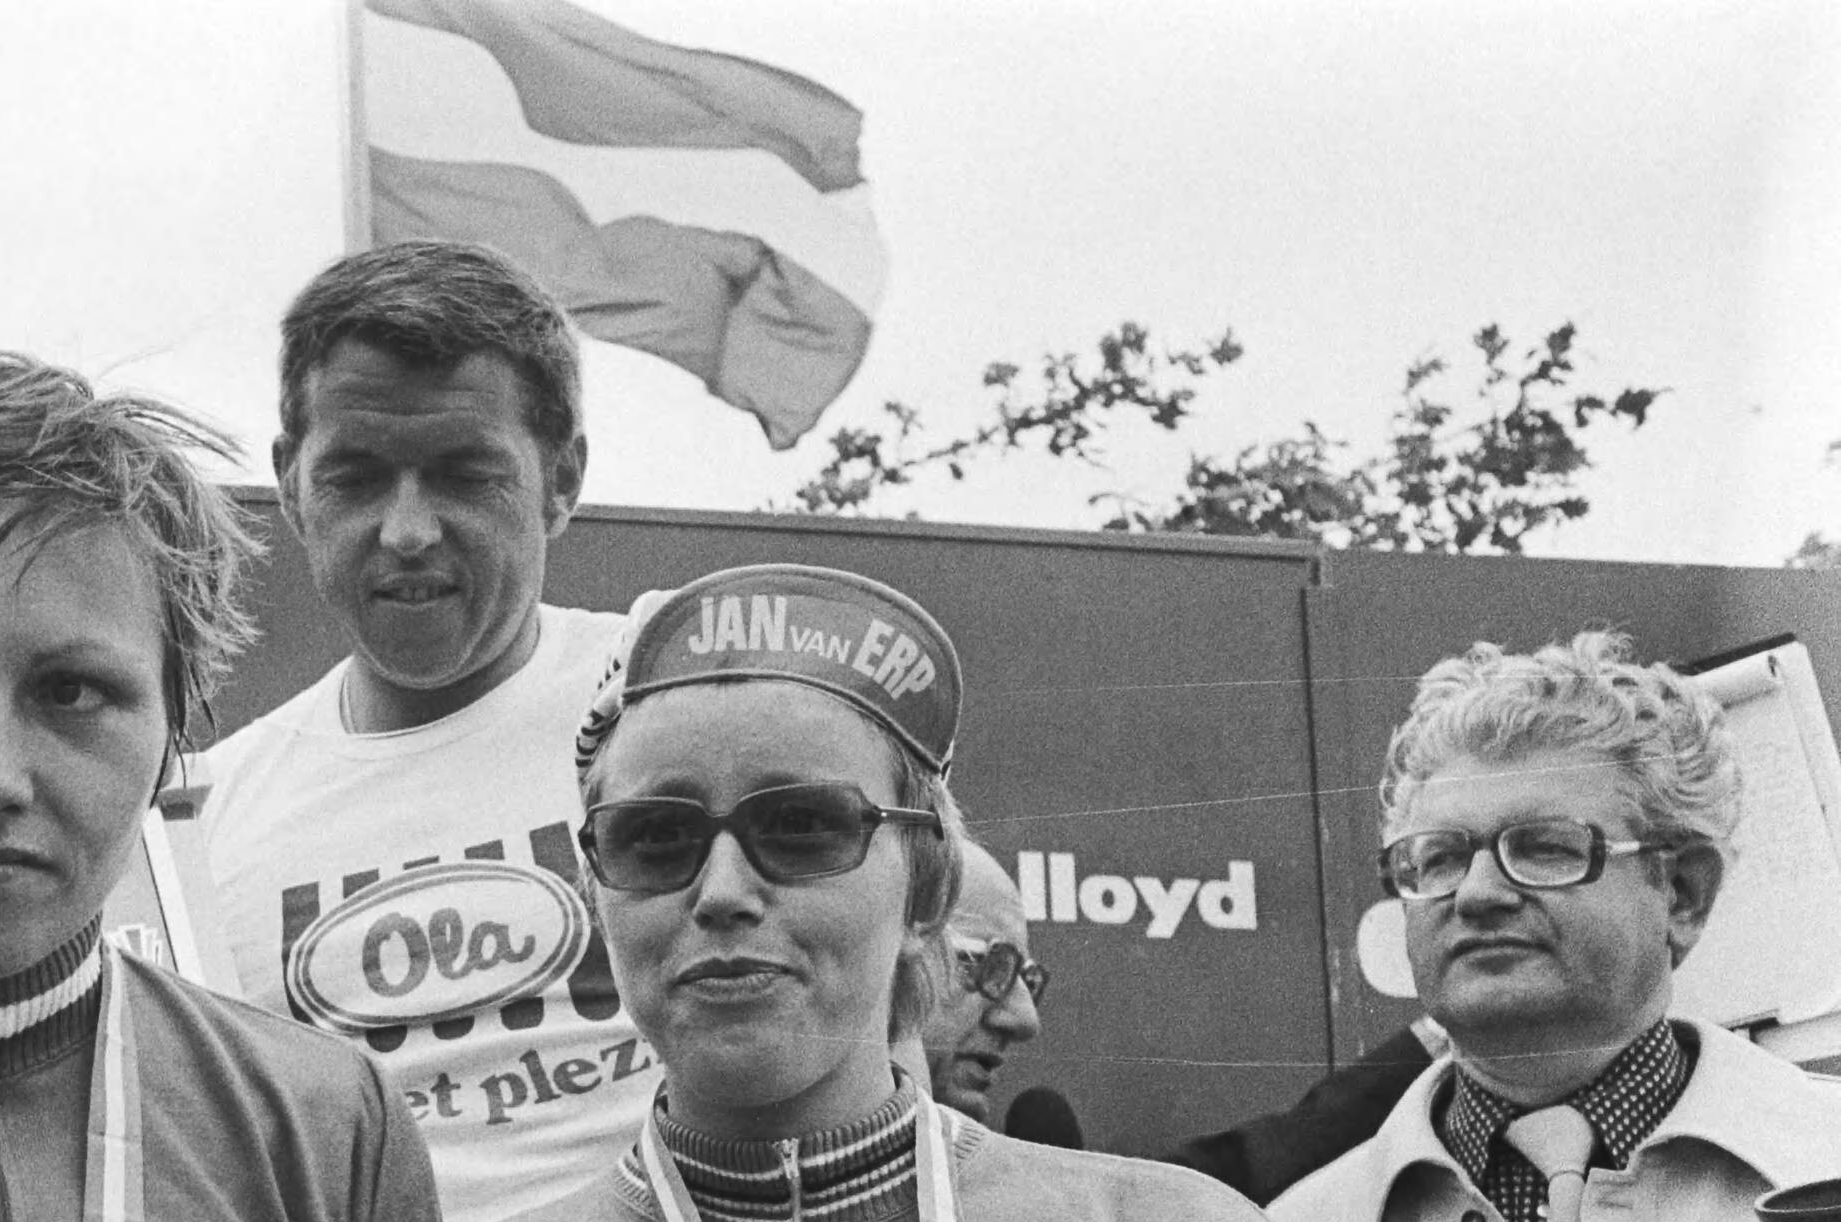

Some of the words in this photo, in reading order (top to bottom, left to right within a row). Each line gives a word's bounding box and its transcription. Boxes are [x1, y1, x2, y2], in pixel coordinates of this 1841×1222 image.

[688, 594, 787, 654] JAN
[789, 624, 851, 664] VAN
[852, 619, 936, 700] ERP
[1018, 851, 1258, 939] lloyd
[361, 908, 535, 997] Ola
